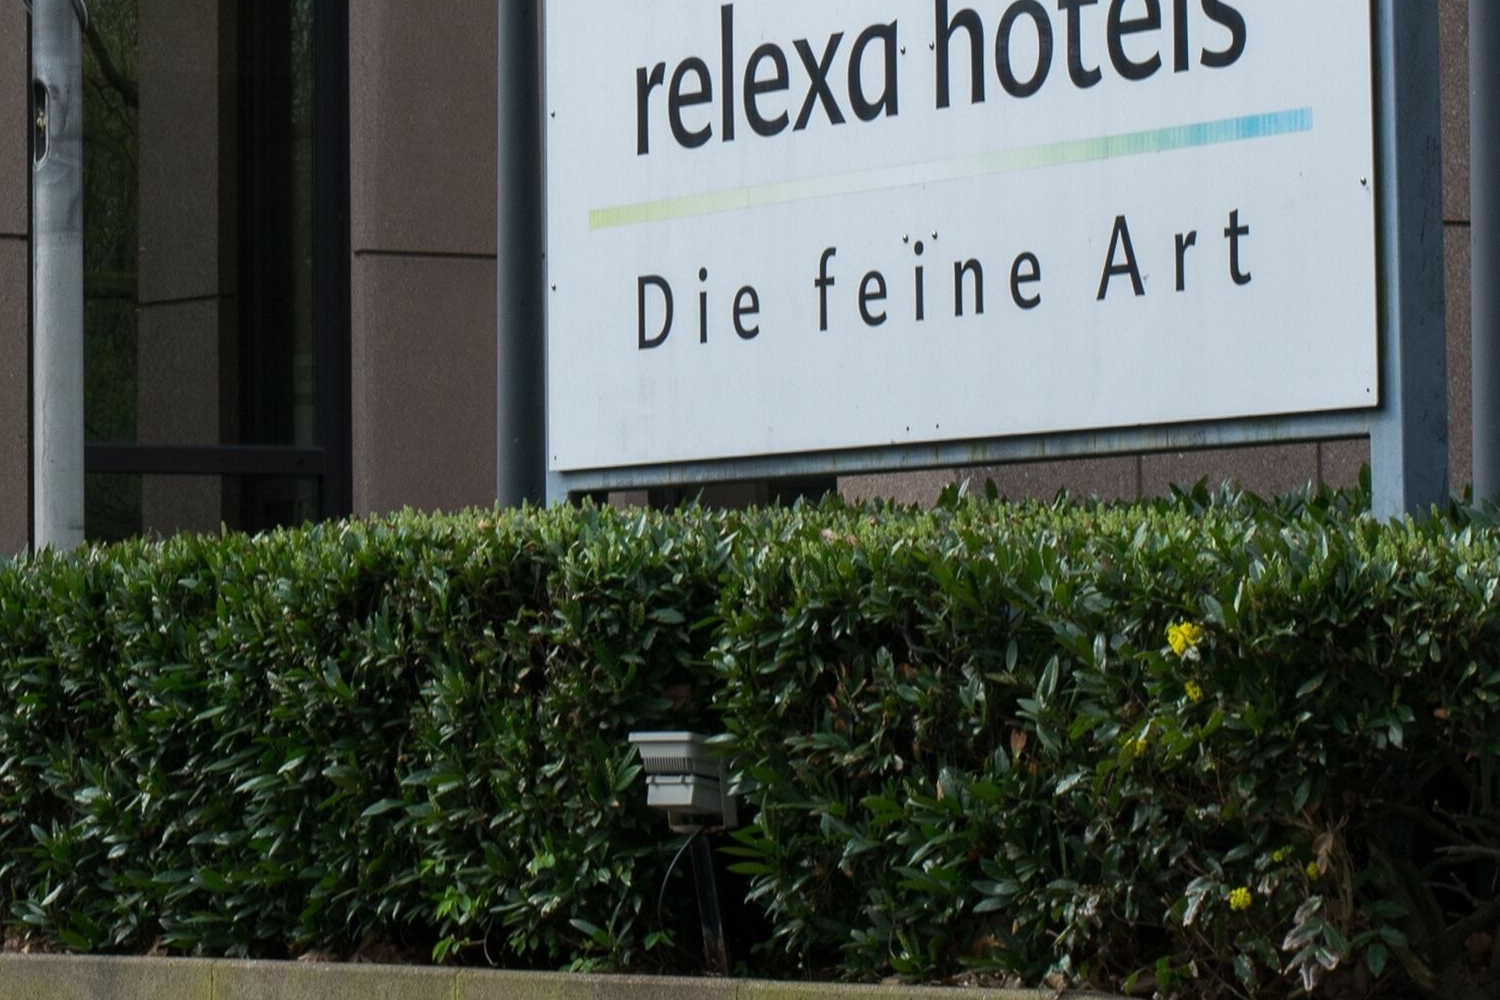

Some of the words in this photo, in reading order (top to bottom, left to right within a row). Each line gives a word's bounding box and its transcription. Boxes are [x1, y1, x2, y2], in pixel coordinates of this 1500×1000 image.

[636, 3, 899, 156] relexa
[637, 266, 760, 350] Die
[814, 240, 1041, 332] feine
[1096, 208, 1252, 301] Art
